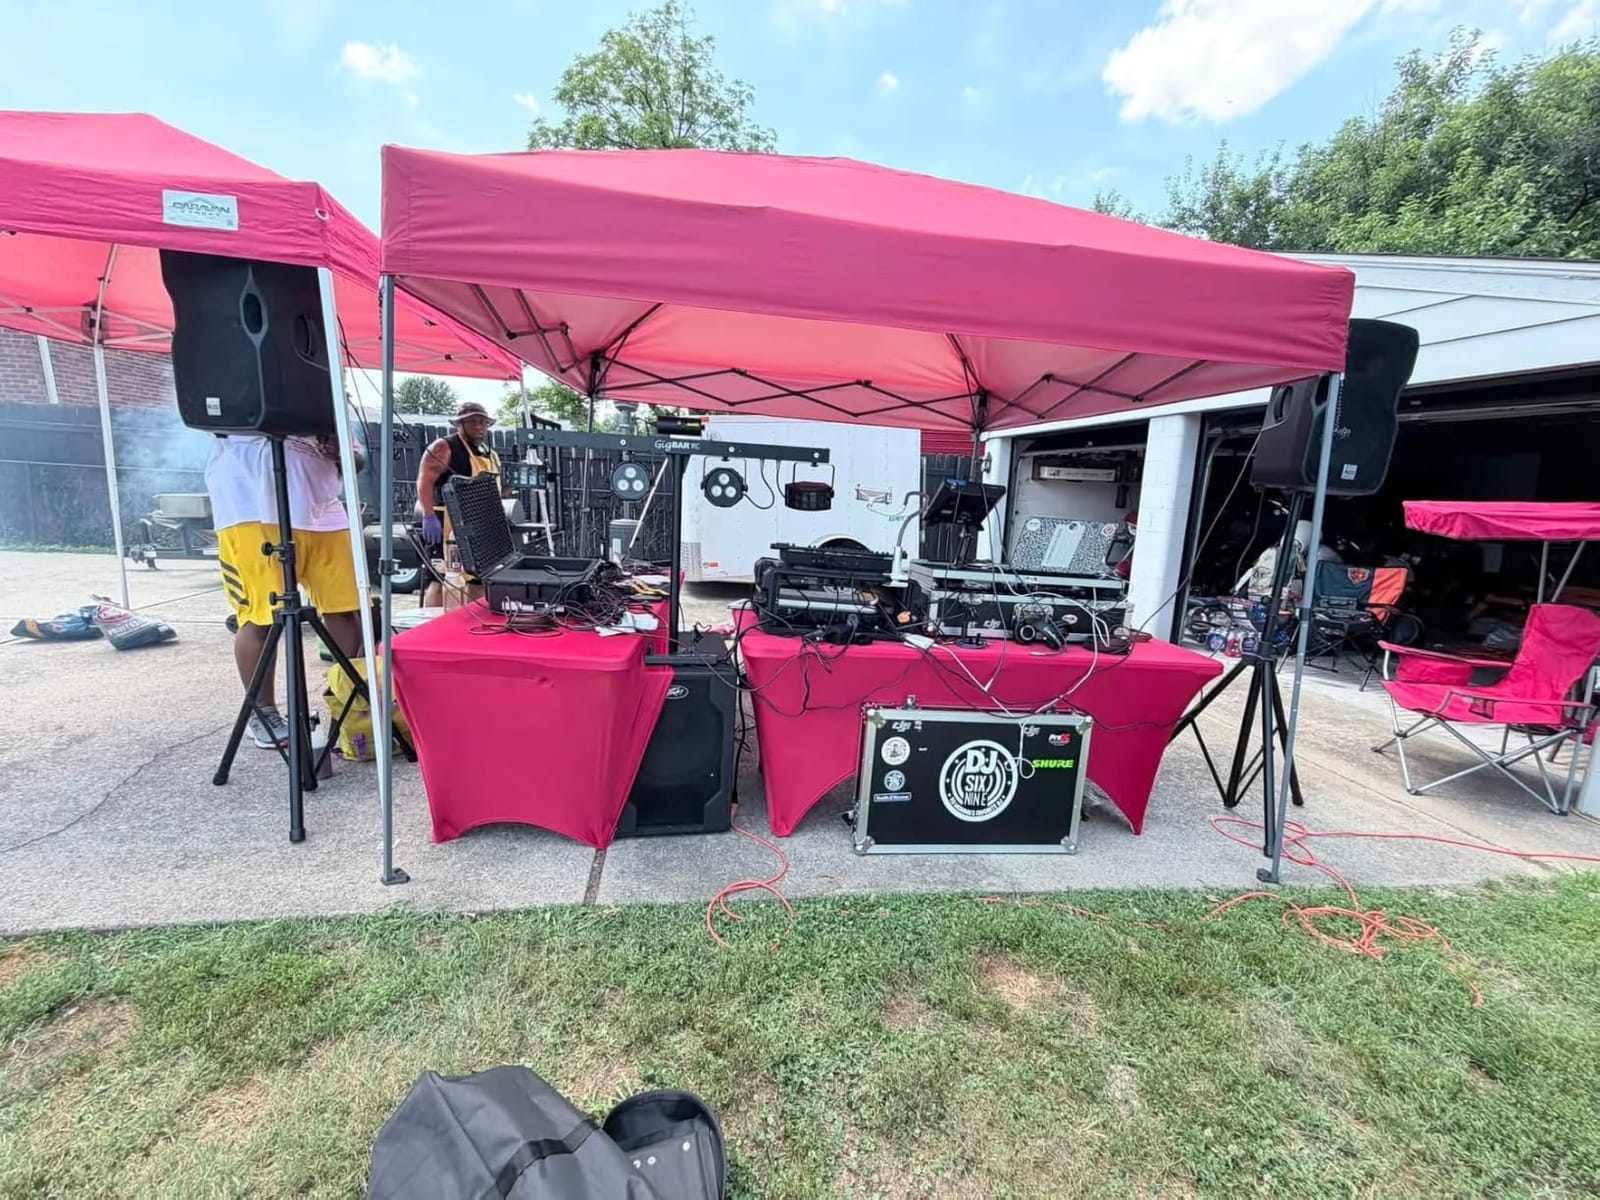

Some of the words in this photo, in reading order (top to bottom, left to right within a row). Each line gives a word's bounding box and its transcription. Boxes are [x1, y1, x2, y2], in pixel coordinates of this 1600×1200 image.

[964, 749, 998, 774] DJ
[1032, 759, 1074, 768] SHURE
[964, 774, 987, 792] SIX
[963, 791, 987, 806] NINE
